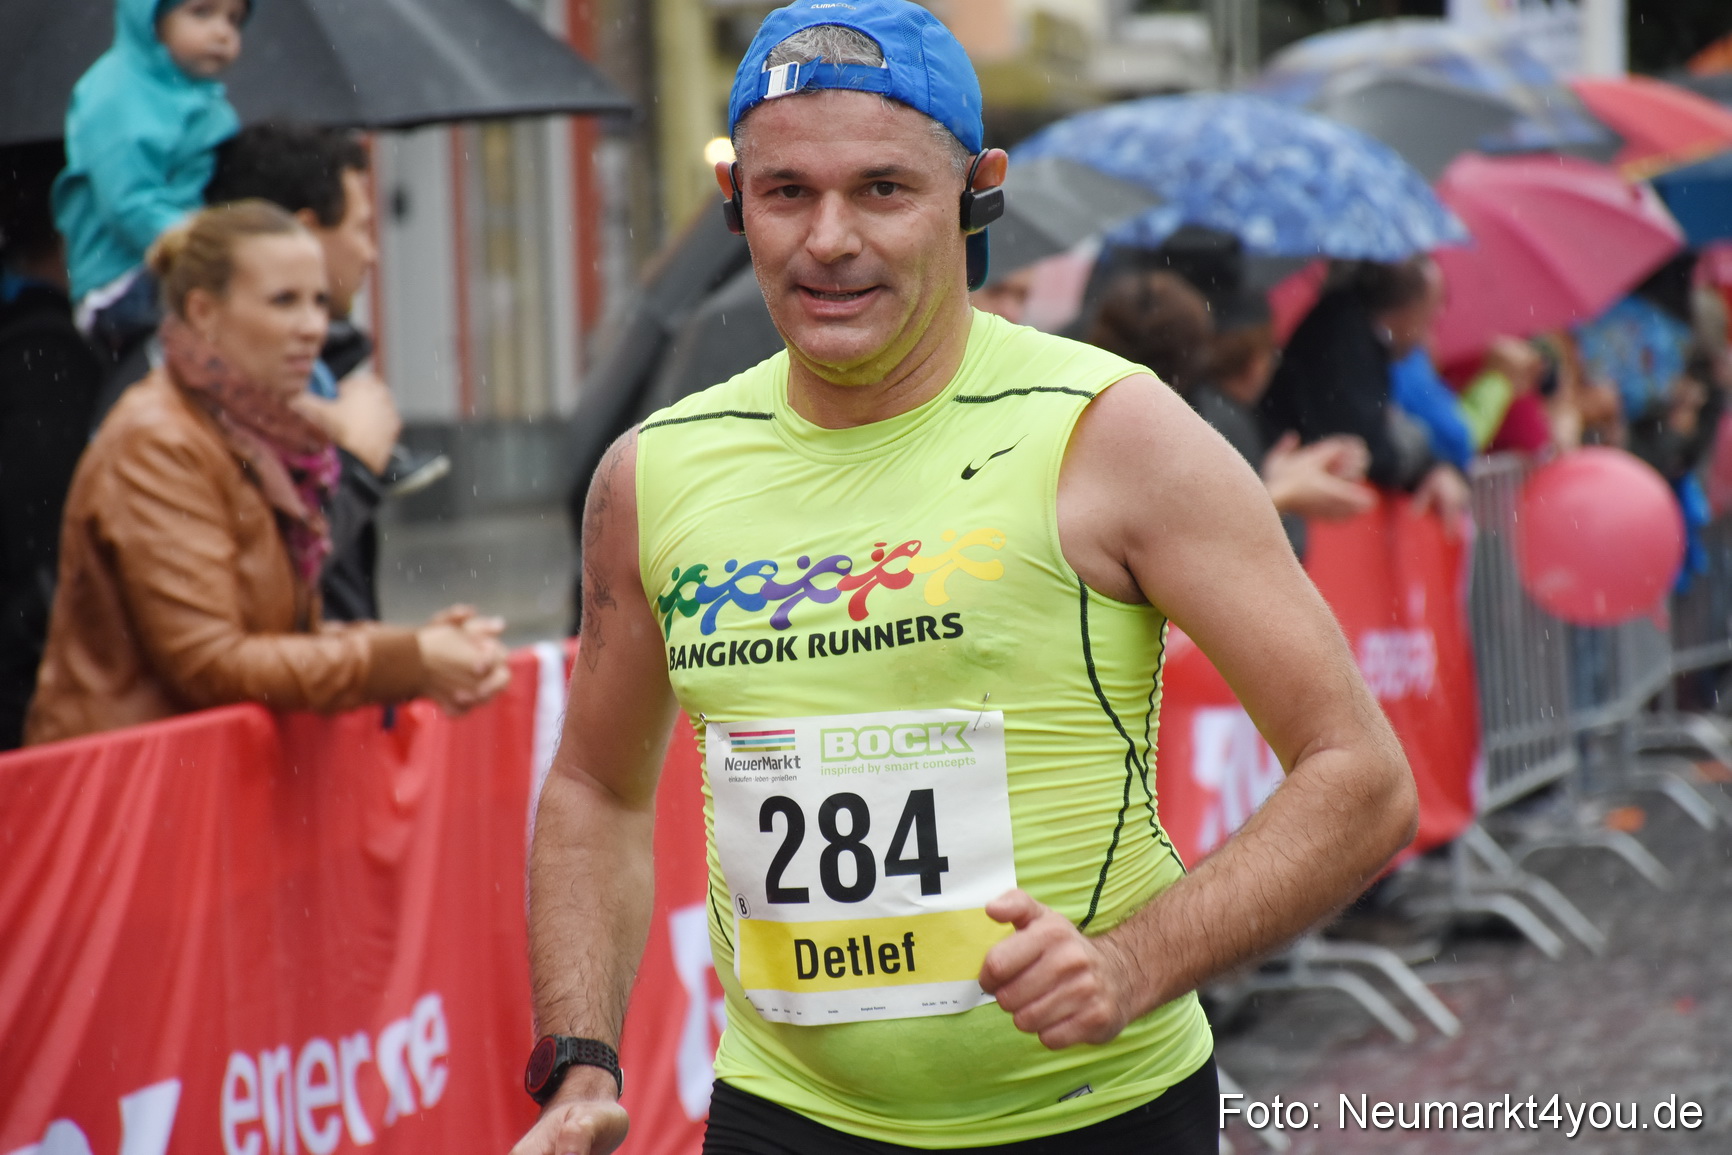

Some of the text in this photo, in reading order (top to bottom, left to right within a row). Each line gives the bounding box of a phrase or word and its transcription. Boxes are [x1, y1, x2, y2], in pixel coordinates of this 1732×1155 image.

[669, 612, 965, 672] BANGKOK RUNNERS
[724, 754, 802, 771] NeuerMarkt
[820, 720, 974, 763] BOCK
[820, 756, 977, 777] inspired by smart concepts
[758, 787, 950, 905] 284
[793, 931, 917, 981] Detlef
